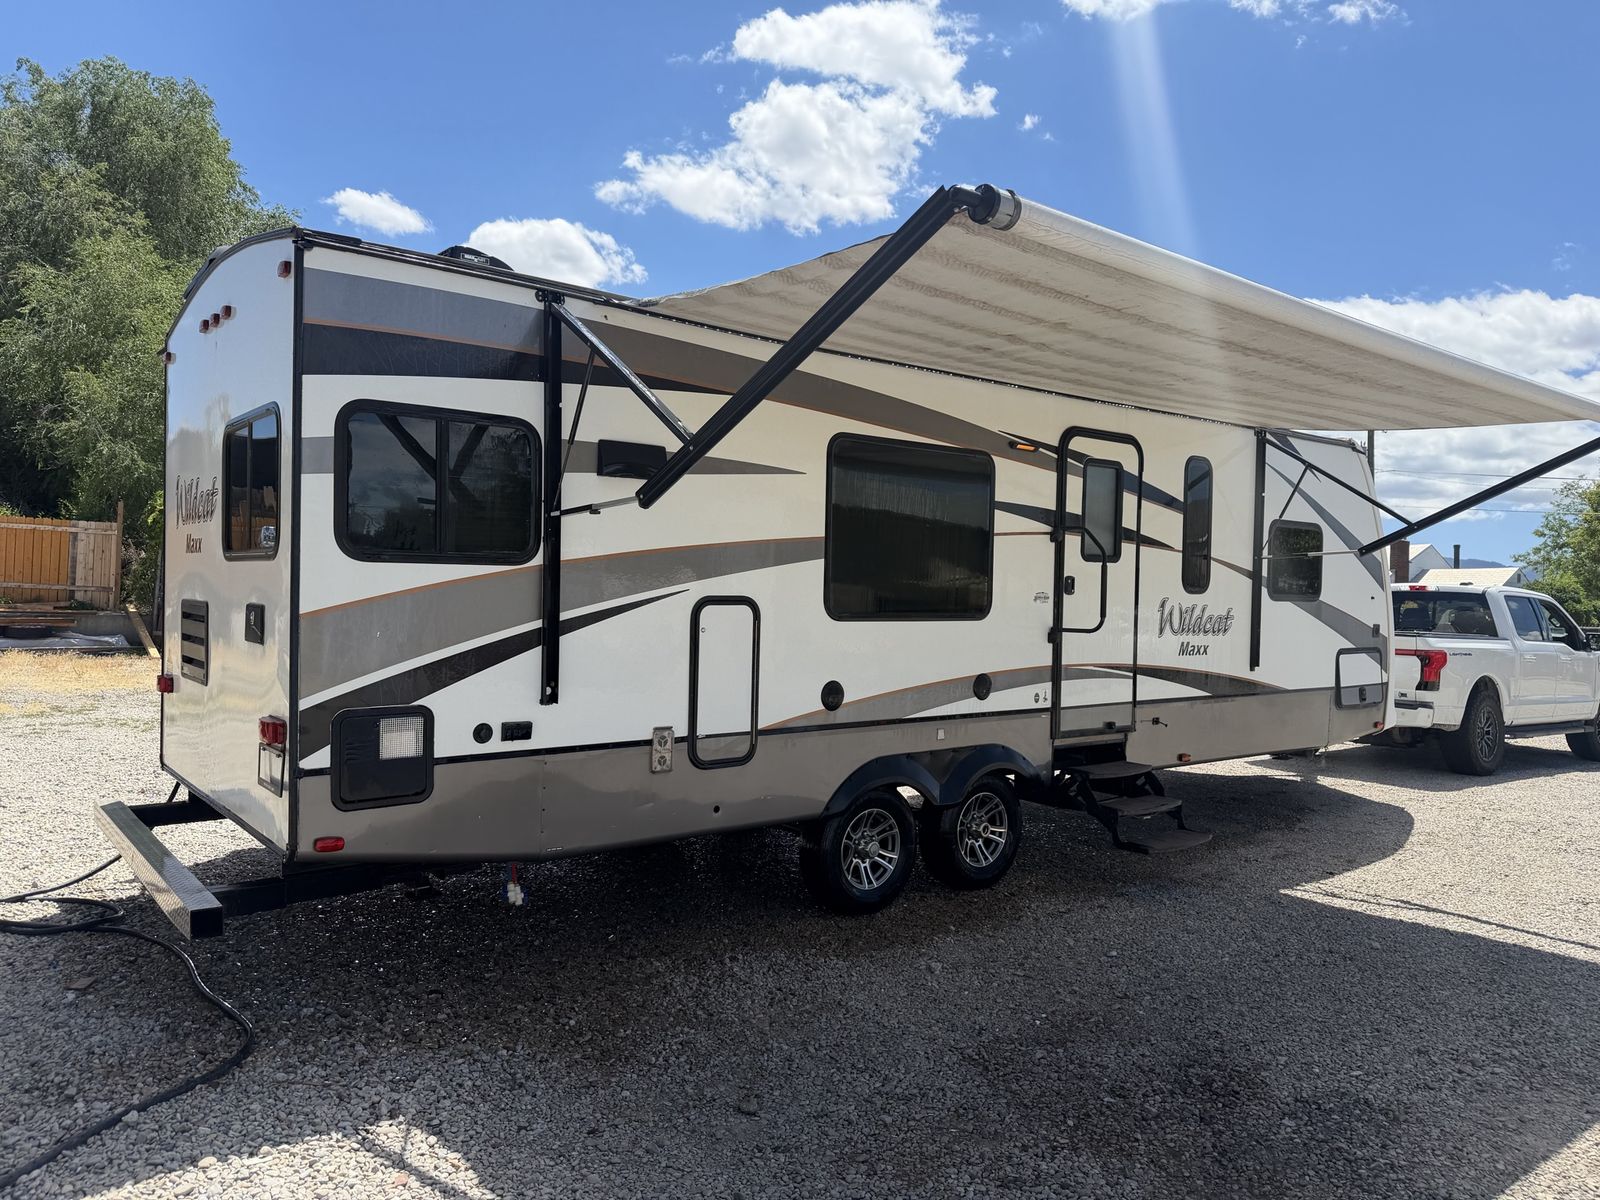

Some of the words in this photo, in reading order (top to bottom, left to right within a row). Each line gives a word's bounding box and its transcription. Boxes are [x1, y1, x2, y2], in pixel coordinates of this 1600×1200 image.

[176, 475, 219, 530] Wildcat
[185, 533, 202, 553] Maxx
[1157, 596, 1235, 639] Wildcat
[1178, 641, 1209, 656] Maxx
